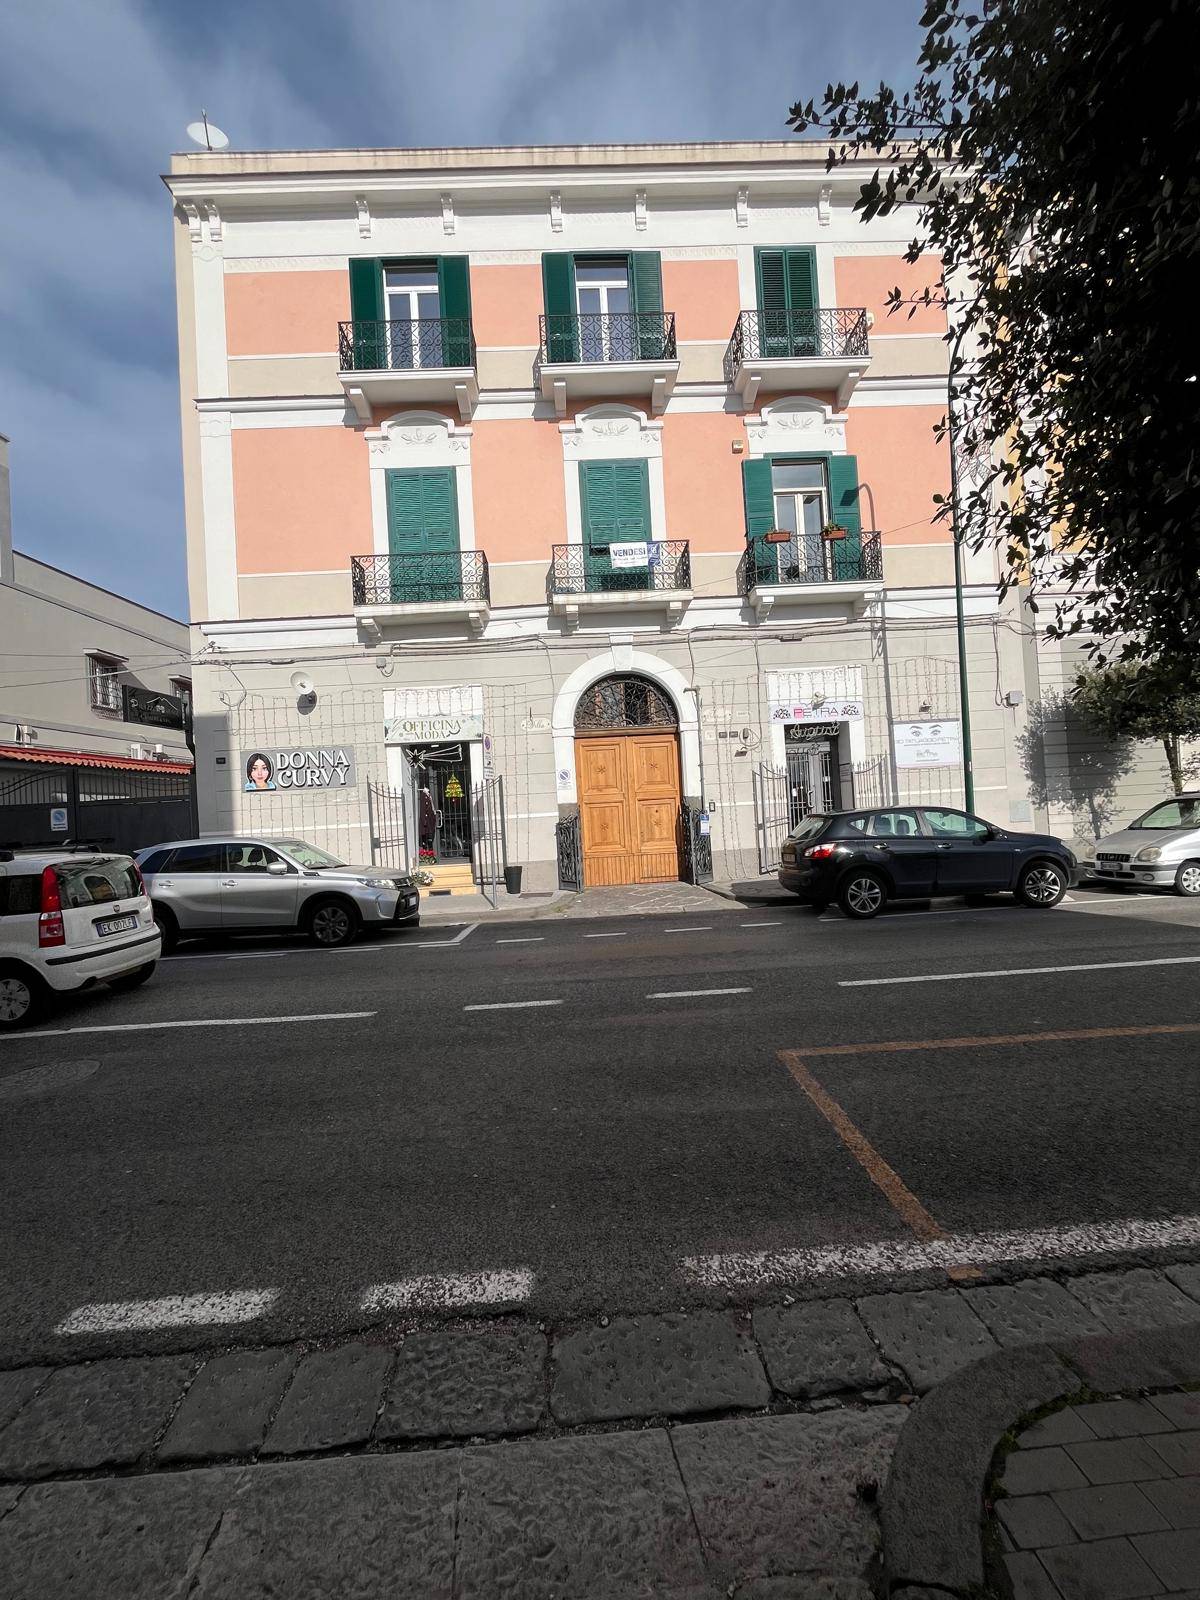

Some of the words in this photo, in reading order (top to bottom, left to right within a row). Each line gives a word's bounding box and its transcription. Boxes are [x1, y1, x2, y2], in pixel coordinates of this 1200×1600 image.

[793, 706, 838, 718] PETRA
[403, 720, 462, 733] OFFICINA
[414, 731, 446, 740] MODA
[276, 750, 350, 770] DONNA
[277, 767, 349, 788] CURVY
